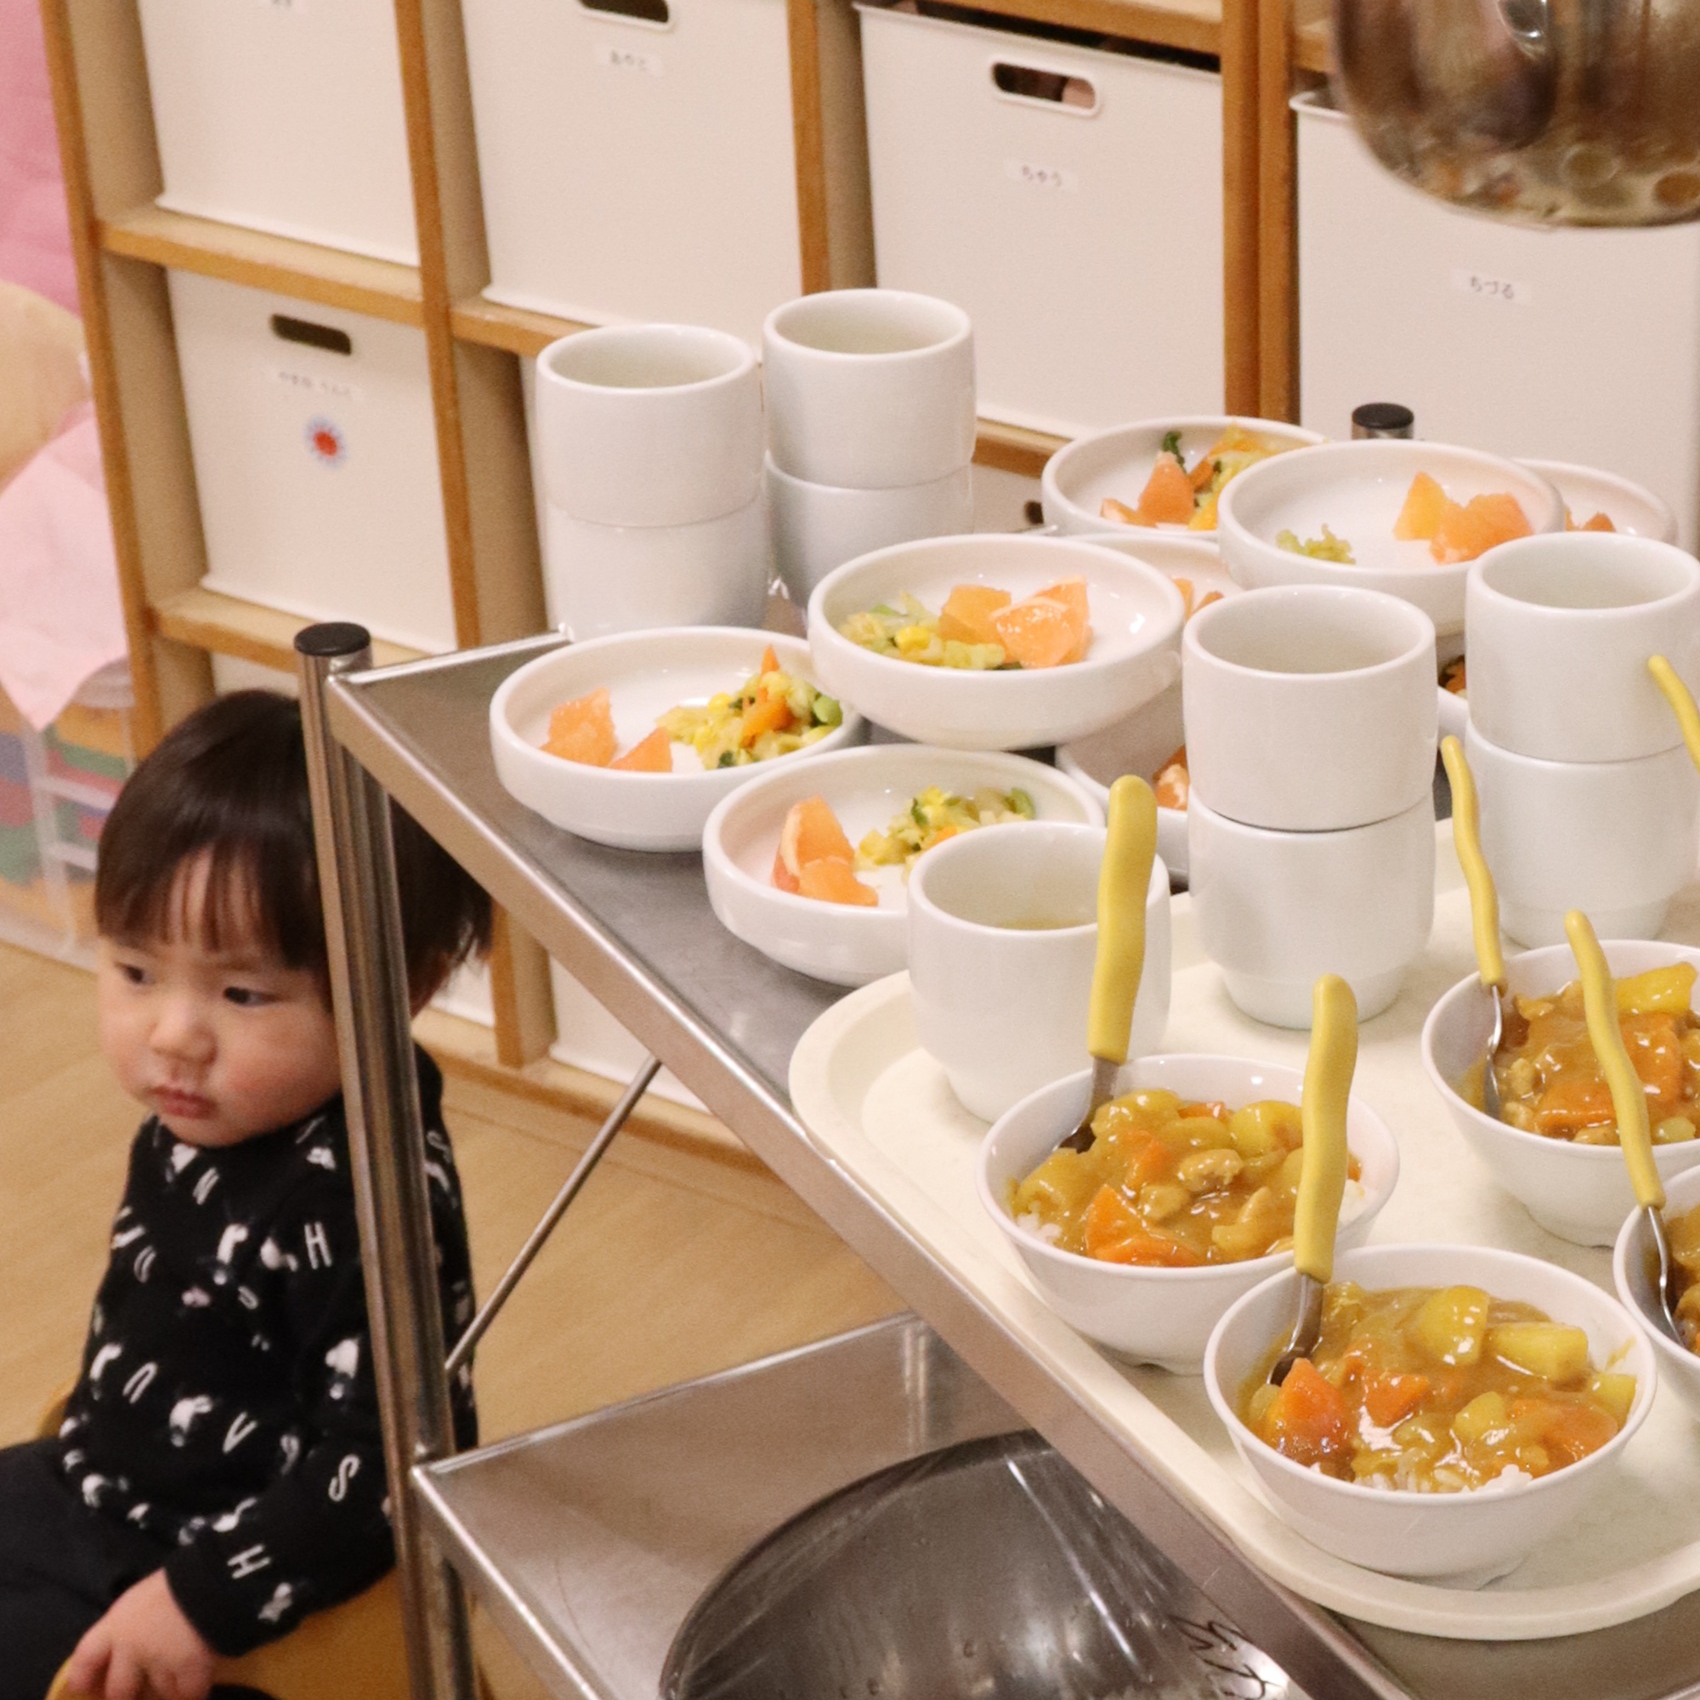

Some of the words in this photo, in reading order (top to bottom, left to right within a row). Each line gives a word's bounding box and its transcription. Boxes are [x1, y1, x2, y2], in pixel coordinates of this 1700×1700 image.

[1470, 275, 1515, 300] ちづる
[305, 1221, 332, 1269] H
[327, 1454, 360, 1501] S
[227, 1544, 271, 1579] H
